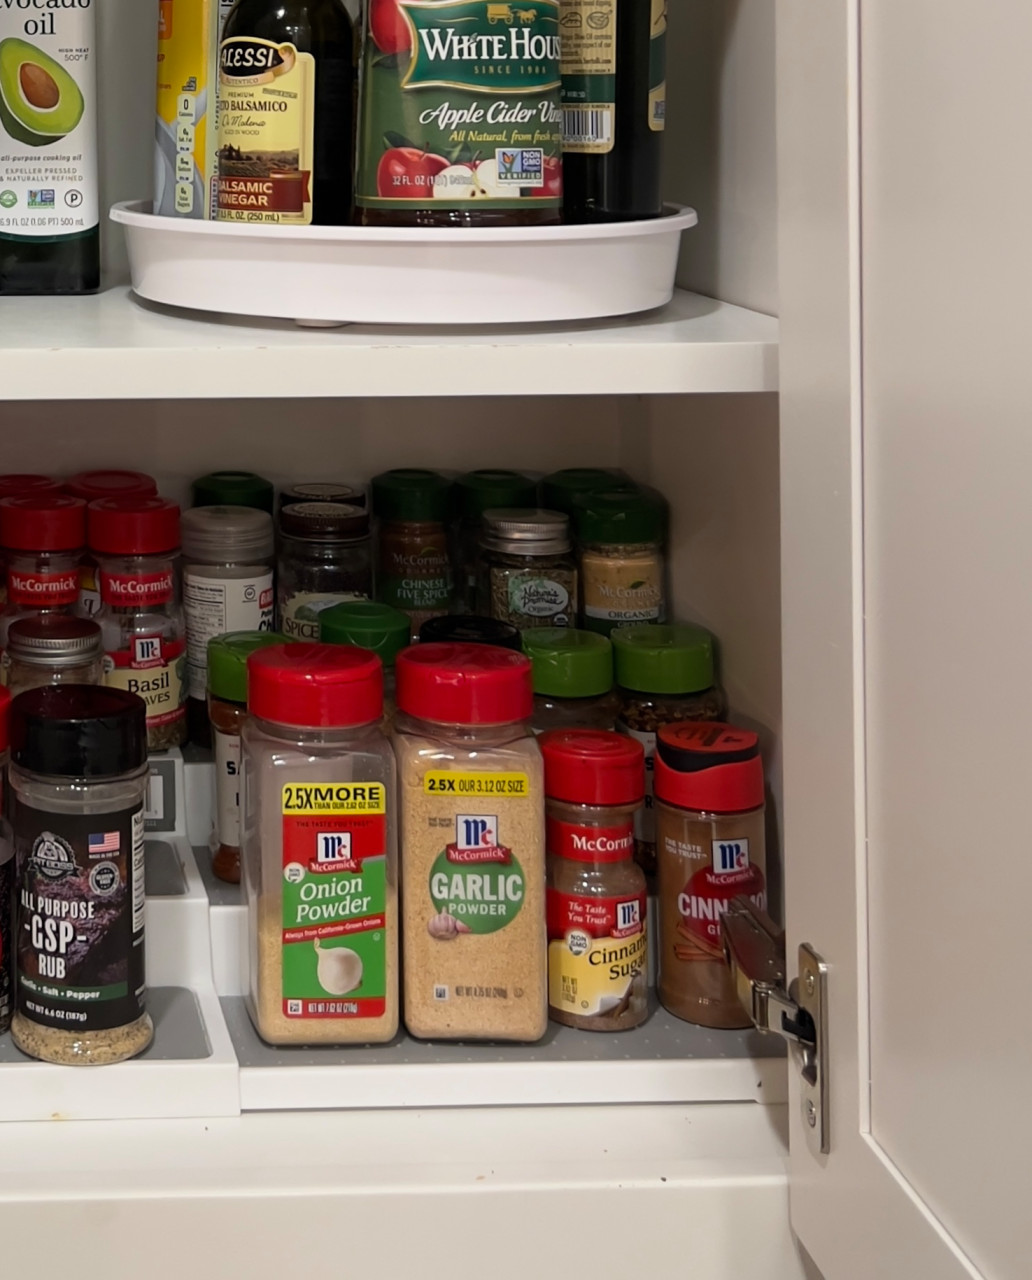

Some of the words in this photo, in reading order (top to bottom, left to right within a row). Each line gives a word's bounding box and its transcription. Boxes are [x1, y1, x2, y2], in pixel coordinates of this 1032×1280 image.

[24, 12, 57, 36] oil
[418, 28, 507, 61] WHITE
[508, 28, 561, 60] HOUS
[221, 48, 274, 67] ALESSI
[474, 66, 511, 74] SINCE
[230, 101, 288, 112] BALSAMICO
[419, 102, 484, 130] Apple
[486, 101, 536, 124] Cider
[449, 130, 465, 141] All
[510, 130, 532, 144] from
[533, 130, 552, 144] fresh
[42, 154, 70, 163] cooking
[522, 158, 541, 166] GMO
[499, 172, 541, 180] VERIFIED
[11, 575, 77, 592] McCormick
[109, 574, 173, 594] McCormick
[401, 578, 445, 589] CHINESE
[397, 589, 419, 599] FIVE
[608, 610, 654, 619] ORGANIC
[128, 671, 170, 695] Basil
[428, 778, 456, 792] 2.5X
[458, 779, 474, 792] OUR
[476, 780, 495, 792] 3.12
[496, 780, 507, 792] OZ
[508, 780, 525, 793] SIZE
[284, 787, 314, 810] 2.5X
[314, 787, 380, 801] MORE
[314, 801, 330, 810] THAN
[331, 801, 344, 809] OUR
[367, 800, 380, 808] SIZE
[678, 841, 702, 853] TASTE
[447, 847, 508, 862] McCormick
[310, 858, 357, 872] McCormick
[705, 871, 755, 886] McCormick
[300, 877, 363, 902] Onion
[431, 872, 523, 901] GARLIC
[21, 888, 35, 911] ALL
[37, 896, 95, 919] PURPOSE
[296, 893, 371, 922] Powder
[448, 902, 507, 916] POWDER
[568, 901, 584, 912] The
[585, 904, 606, 915] Taste
[363, 917, 381, 927] Onions
[568, 912, 584, 923] You
[570, 934, 587, 943] NON
[570, 940, 588, 950] GMO
[588, 934, 647, 966] Cinnam
[38, 954, 66, 979] RUB
[42, 985, 59, 995] Salt
[66, 988, 101, 999] Pepper
